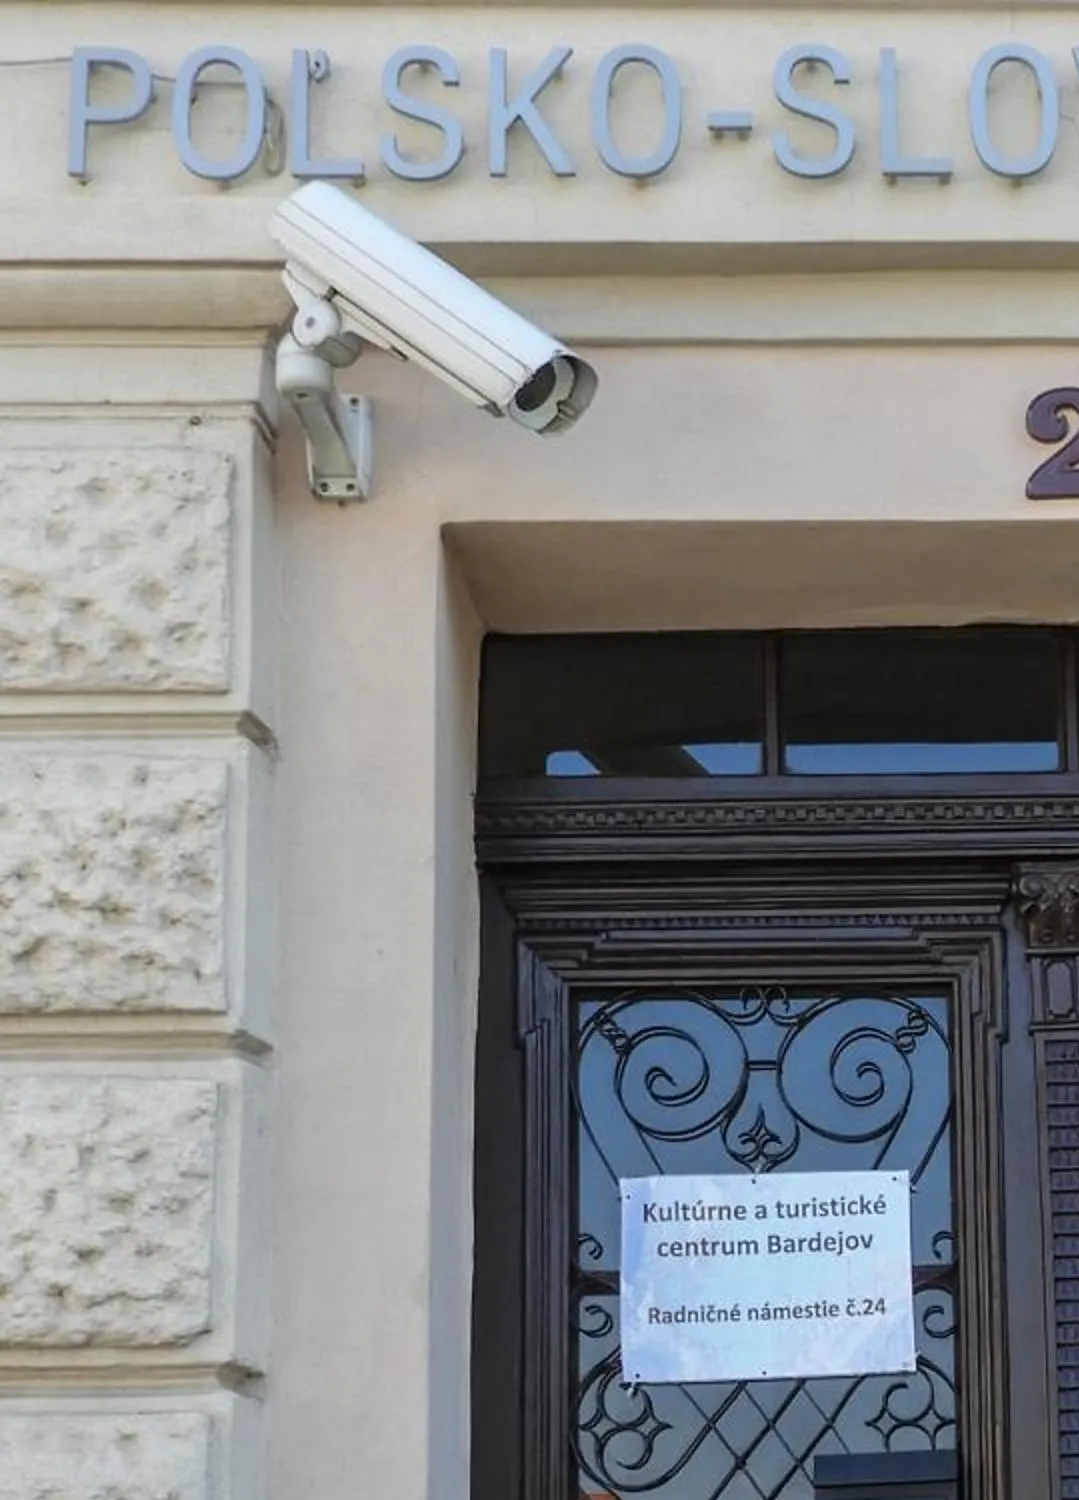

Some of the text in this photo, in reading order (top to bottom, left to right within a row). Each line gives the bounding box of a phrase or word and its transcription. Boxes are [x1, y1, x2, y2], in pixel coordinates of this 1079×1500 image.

[643, 1194, 887, 1223] Kultúrne a turistické
[657, 1232, 874, 1257] centrum Bardejov
[648, 1298, 886, 1324] Radničné námestie č.24
